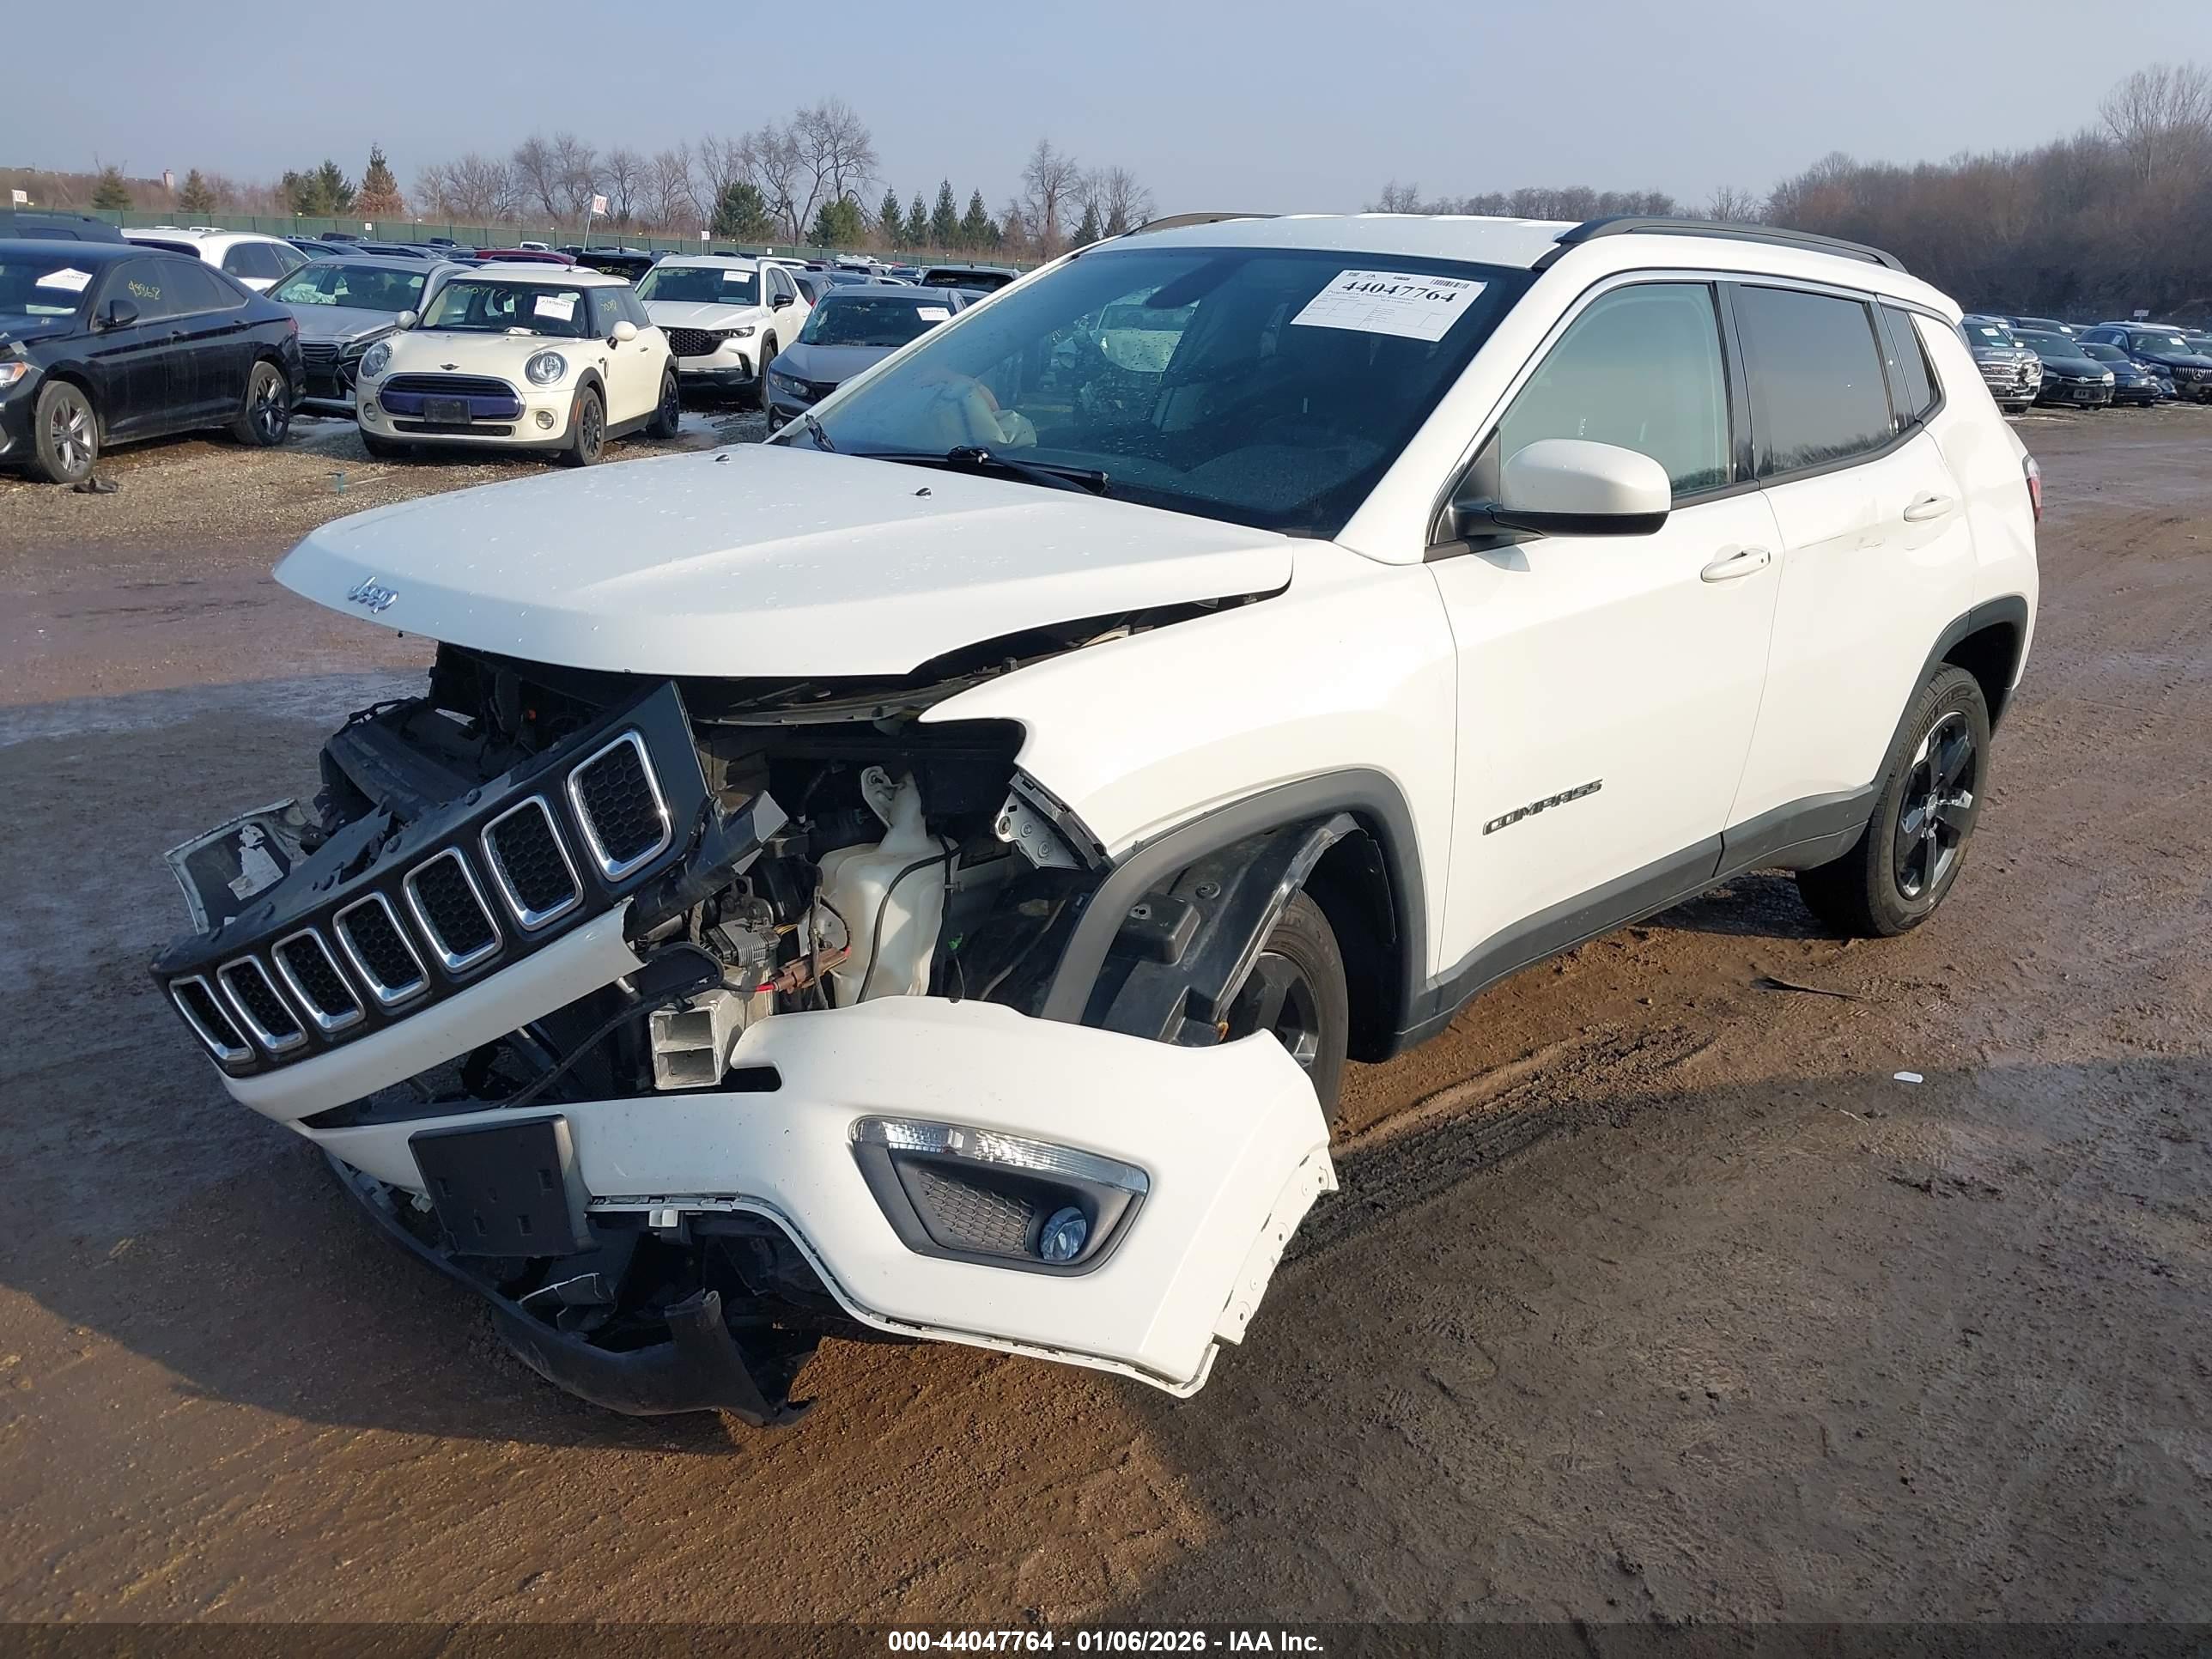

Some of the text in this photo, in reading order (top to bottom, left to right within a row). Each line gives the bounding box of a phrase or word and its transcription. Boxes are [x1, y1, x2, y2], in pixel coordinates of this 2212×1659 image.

[1342, 281, 1457, 302] 44047764
[347, 576, 398, 614] Jeep
[1482, 778, 1603, 836] COMPASS
